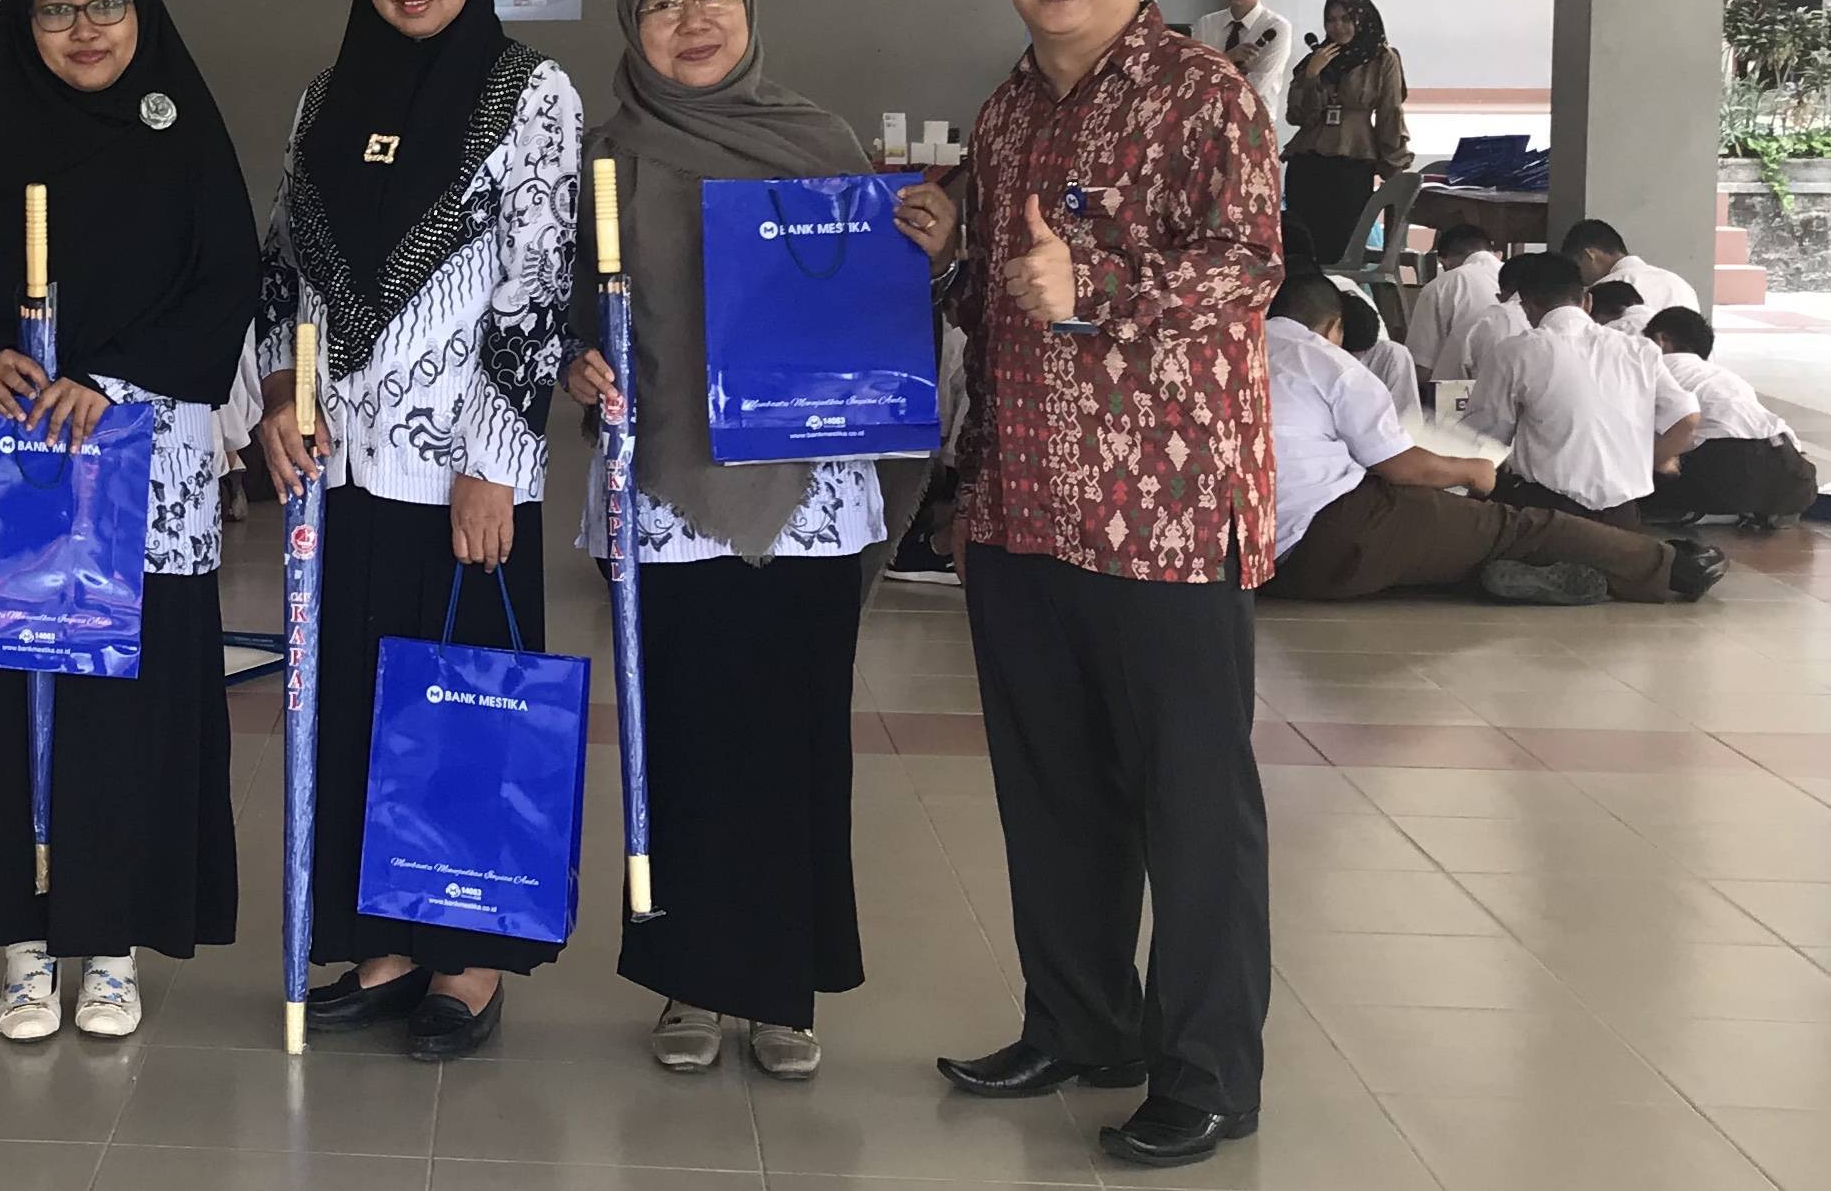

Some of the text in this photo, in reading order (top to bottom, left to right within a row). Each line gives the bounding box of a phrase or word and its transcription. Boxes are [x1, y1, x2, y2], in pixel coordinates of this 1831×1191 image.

[817, 221, 871, 235] MESIKA
[607, 471, 626, 582] KAPAL
[287, 603, 308, 710] KAPAL
[444, 690, 477, 705] BANK
[478, 694, 529, 712] MESTIKA
